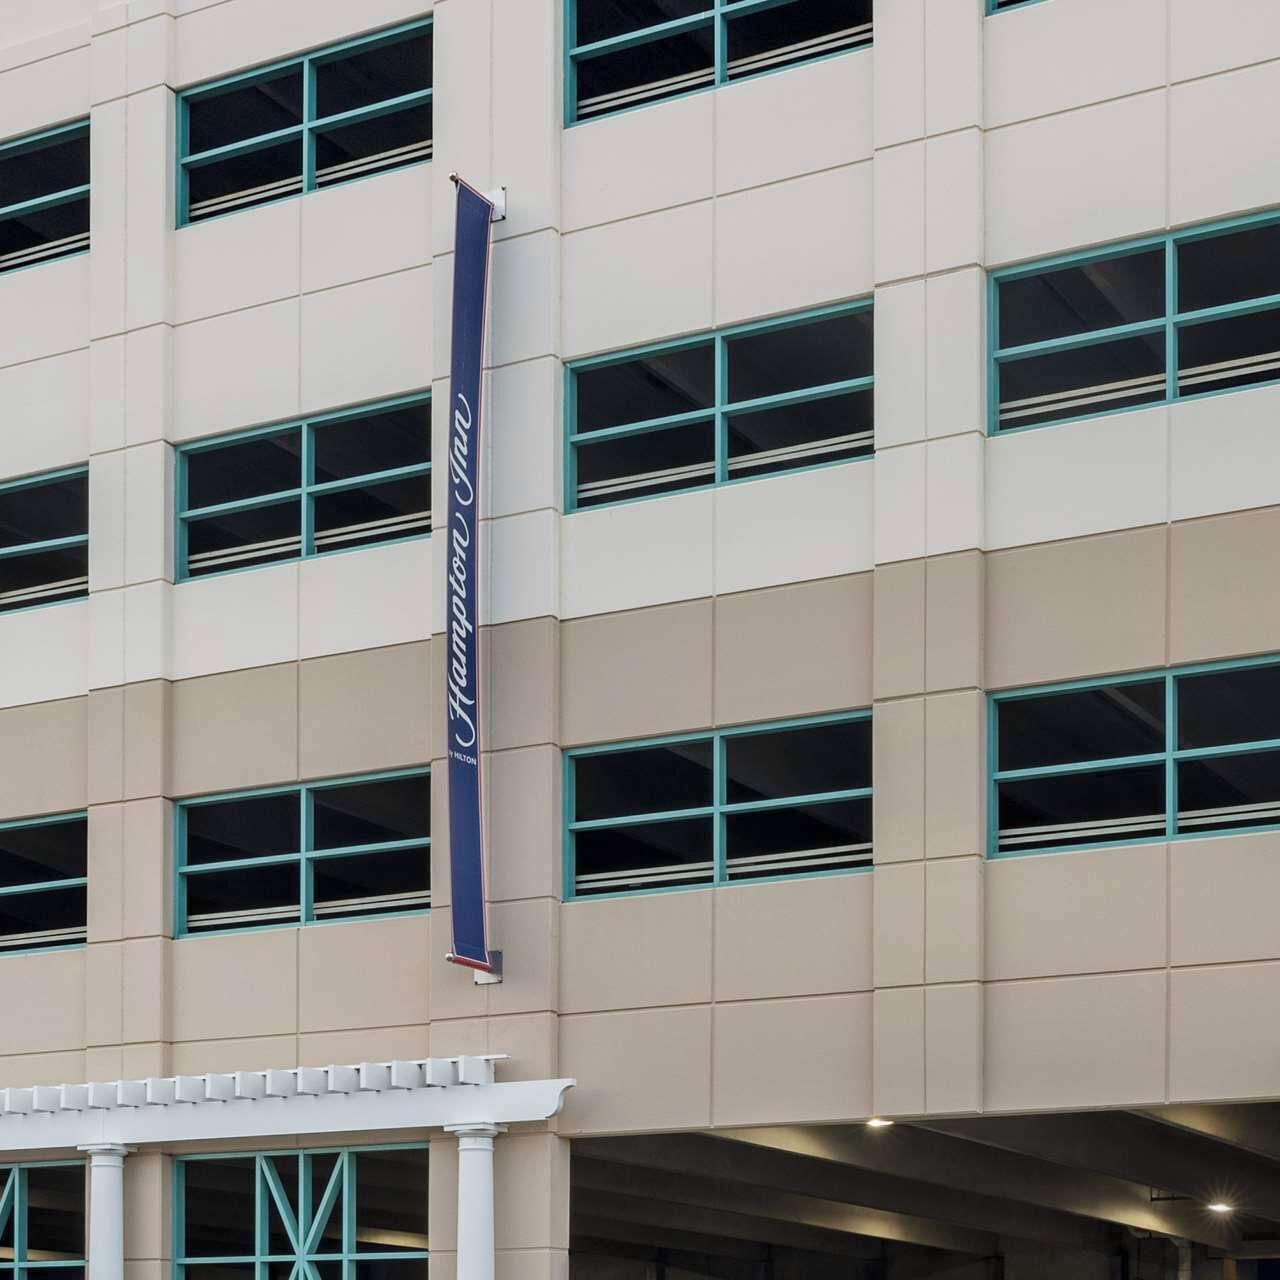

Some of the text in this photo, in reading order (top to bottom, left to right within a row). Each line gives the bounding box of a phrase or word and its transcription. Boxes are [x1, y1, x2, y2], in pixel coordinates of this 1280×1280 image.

[448, 393, 476, 748] Hampton Inn
[454, 751, 477, 766] HILTON
